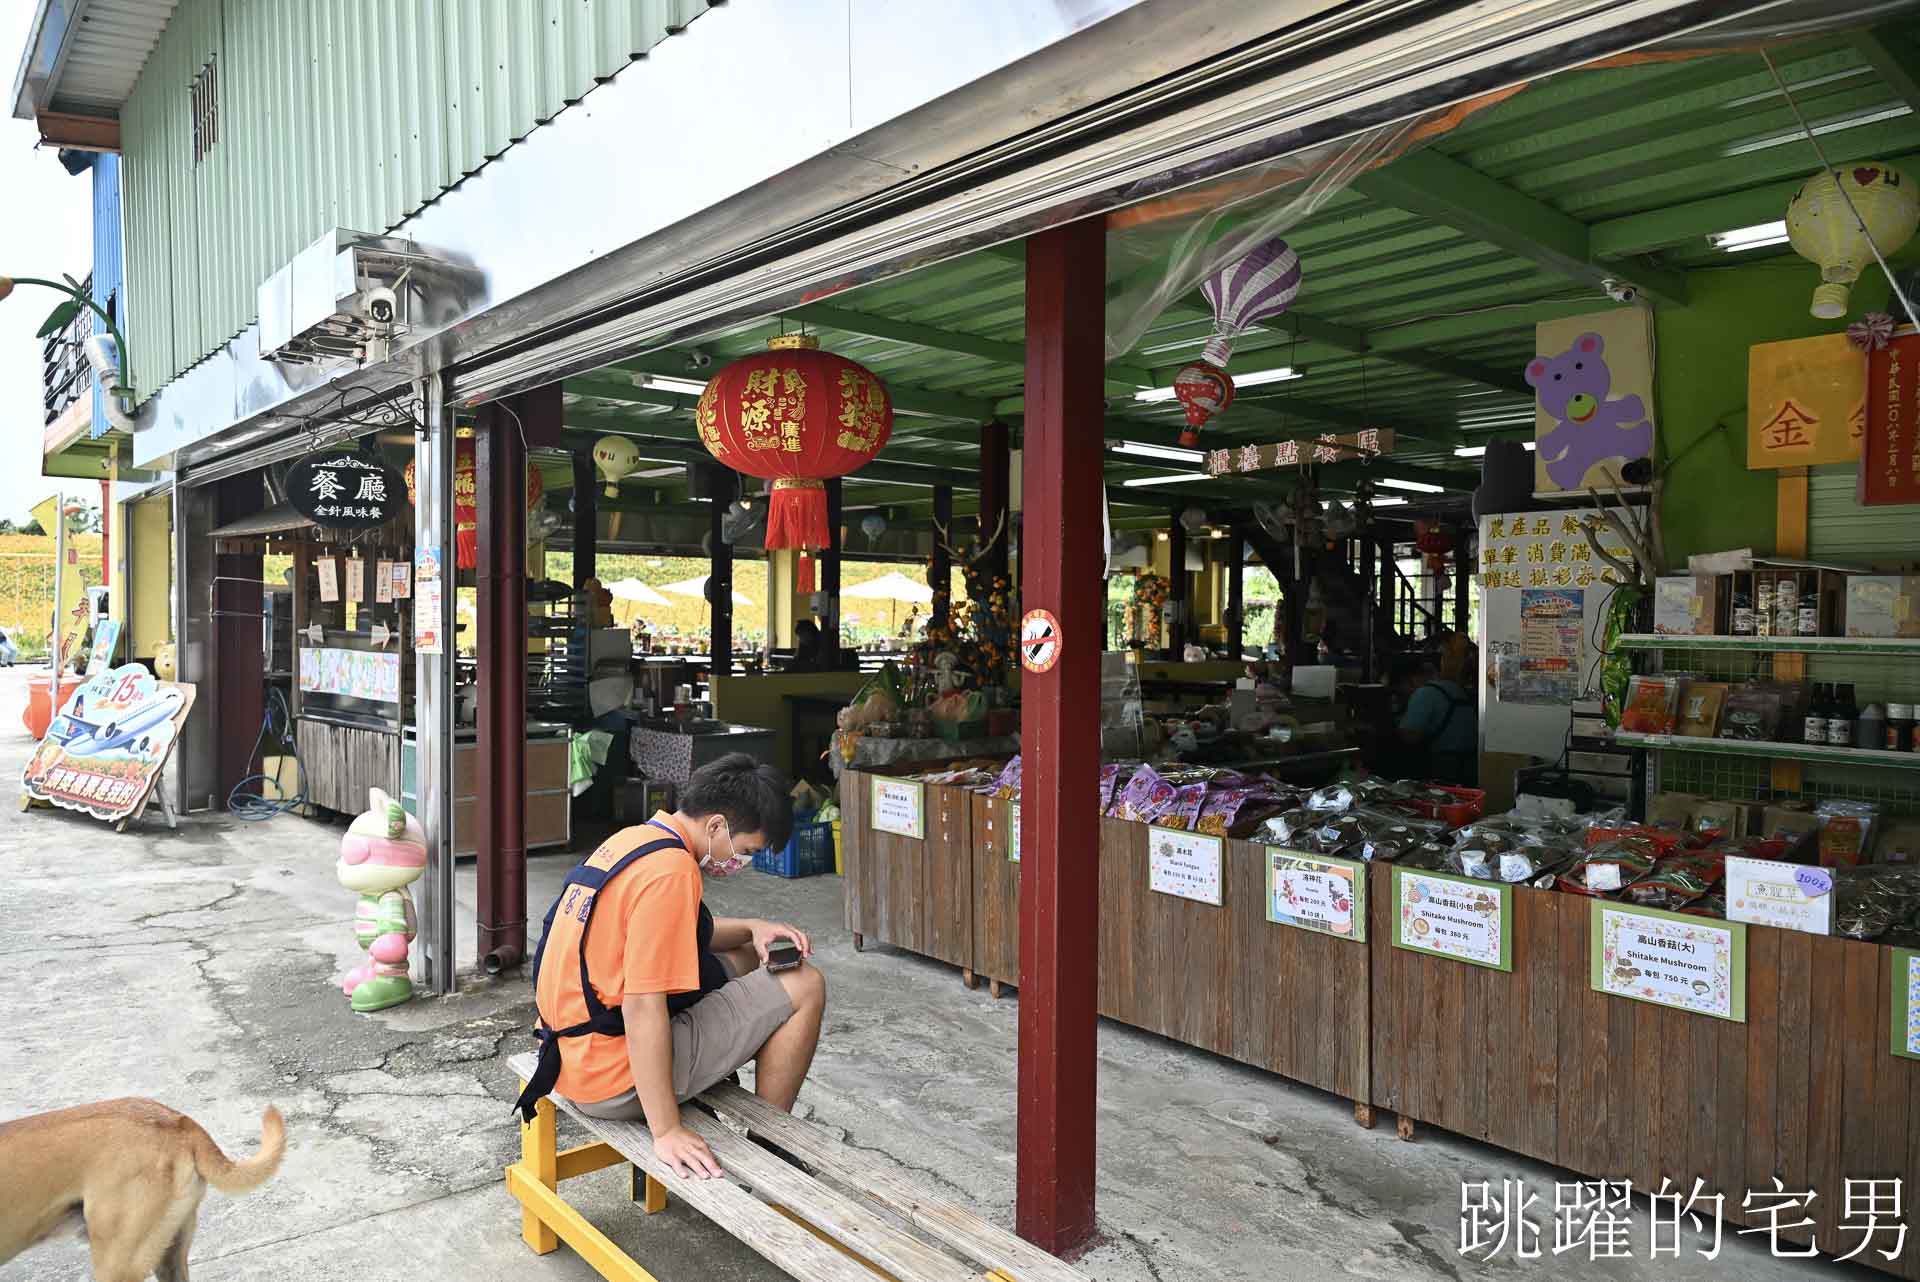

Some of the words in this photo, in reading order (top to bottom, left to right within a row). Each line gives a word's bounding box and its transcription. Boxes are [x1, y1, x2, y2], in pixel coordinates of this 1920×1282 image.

[309, 469, 387, 501] 餐廳
[111, 673, 143, 702] 15
[1421, 910, 1446, 921] Shitake
[1447, 916, 1484, 928] Mushroom
[1637, 934, 1695, 954] 高山香菇(大)
[1627, 950, 1658, 963] Shitake
[1660, 958, 1707, 972] Mushroom
[1645, 969, 1660, 979] 每包
[1664, 974, 1678, 983] 750
[1680, 977, 1688, 985] 元
